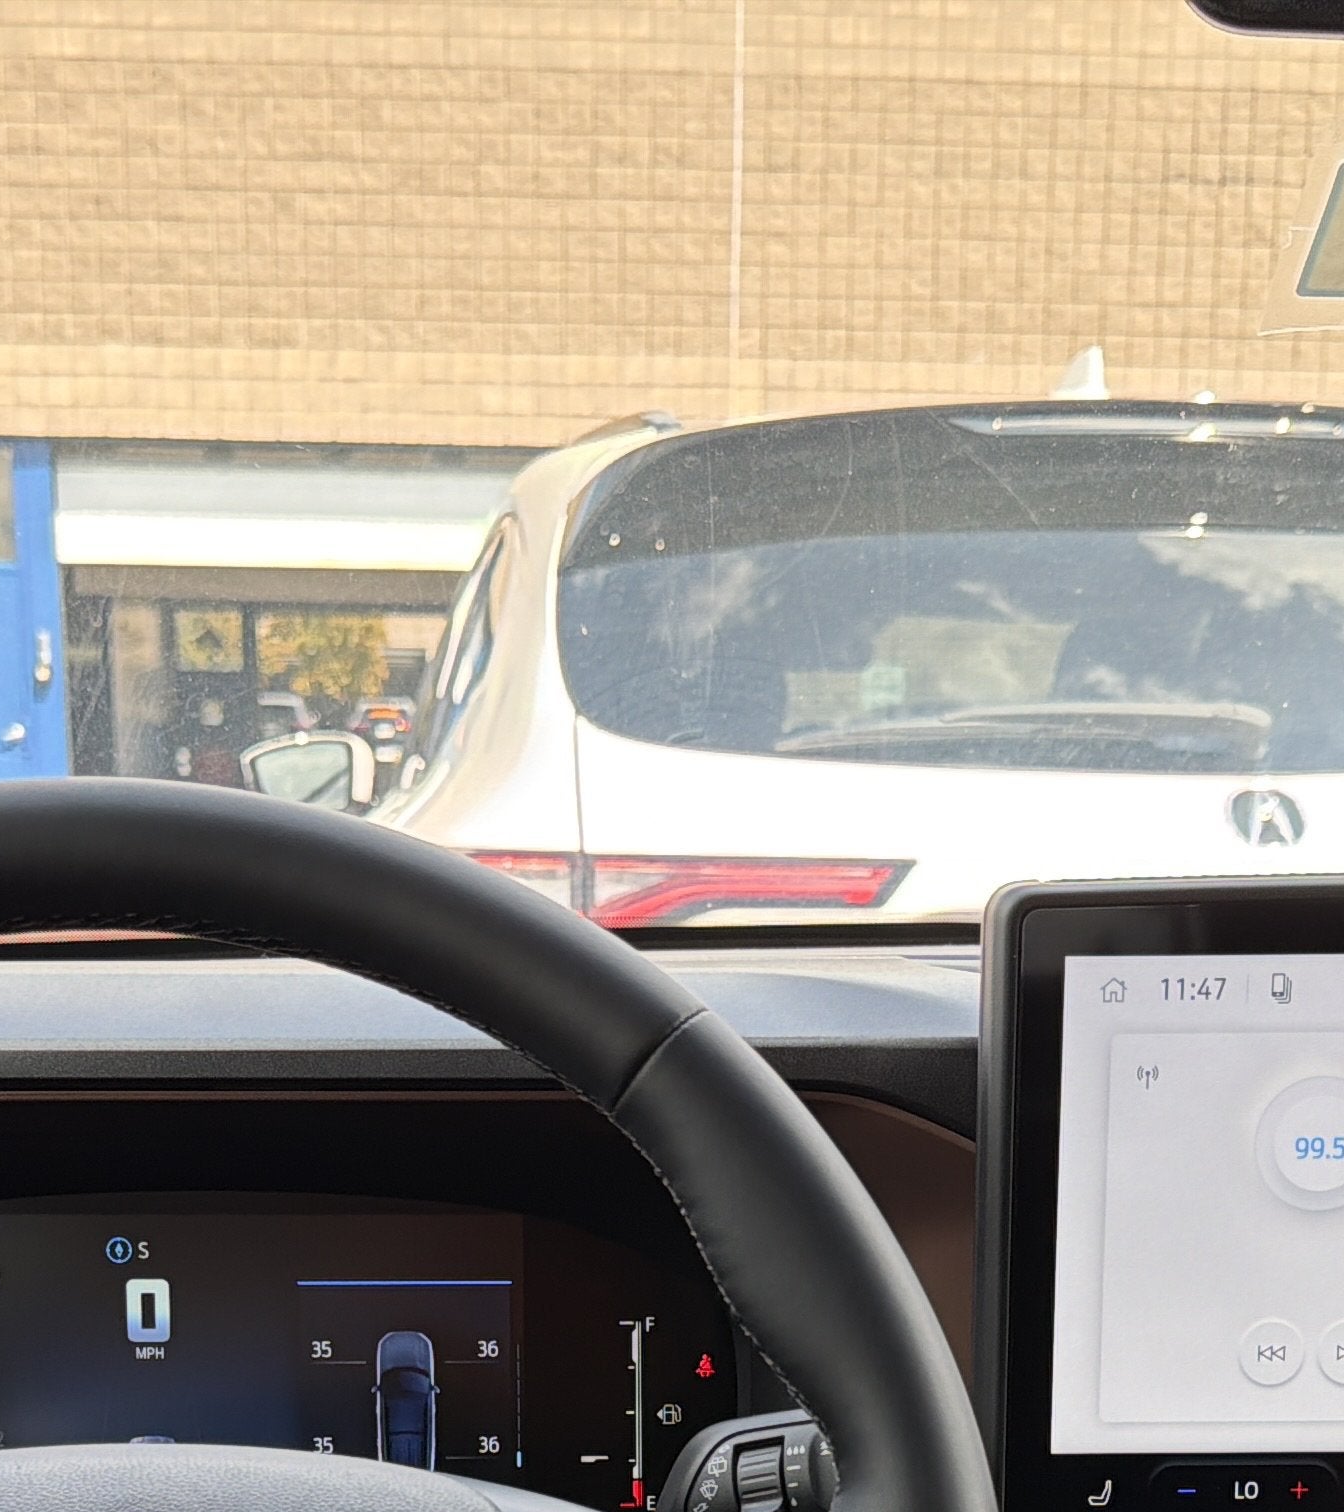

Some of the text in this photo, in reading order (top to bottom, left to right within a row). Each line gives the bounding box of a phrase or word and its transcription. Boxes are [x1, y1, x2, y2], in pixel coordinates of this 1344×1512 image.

[1160, 976, 1228, 1001] 11:47
[138, 1243, 150, 1259] S
[125, 1278, 171, 1342] 0
[645, 1317, 656, 1332] F
[136, 1346, 165, 1360] MPH
[311, 1340, 332, 1359] 35
[477, 1340, 499, 1358] 36
[312, 1437, 334, 1455] 35
[478, 1436, 500, 1455] 36
[1234, 1481, 1259, 1500] LO
